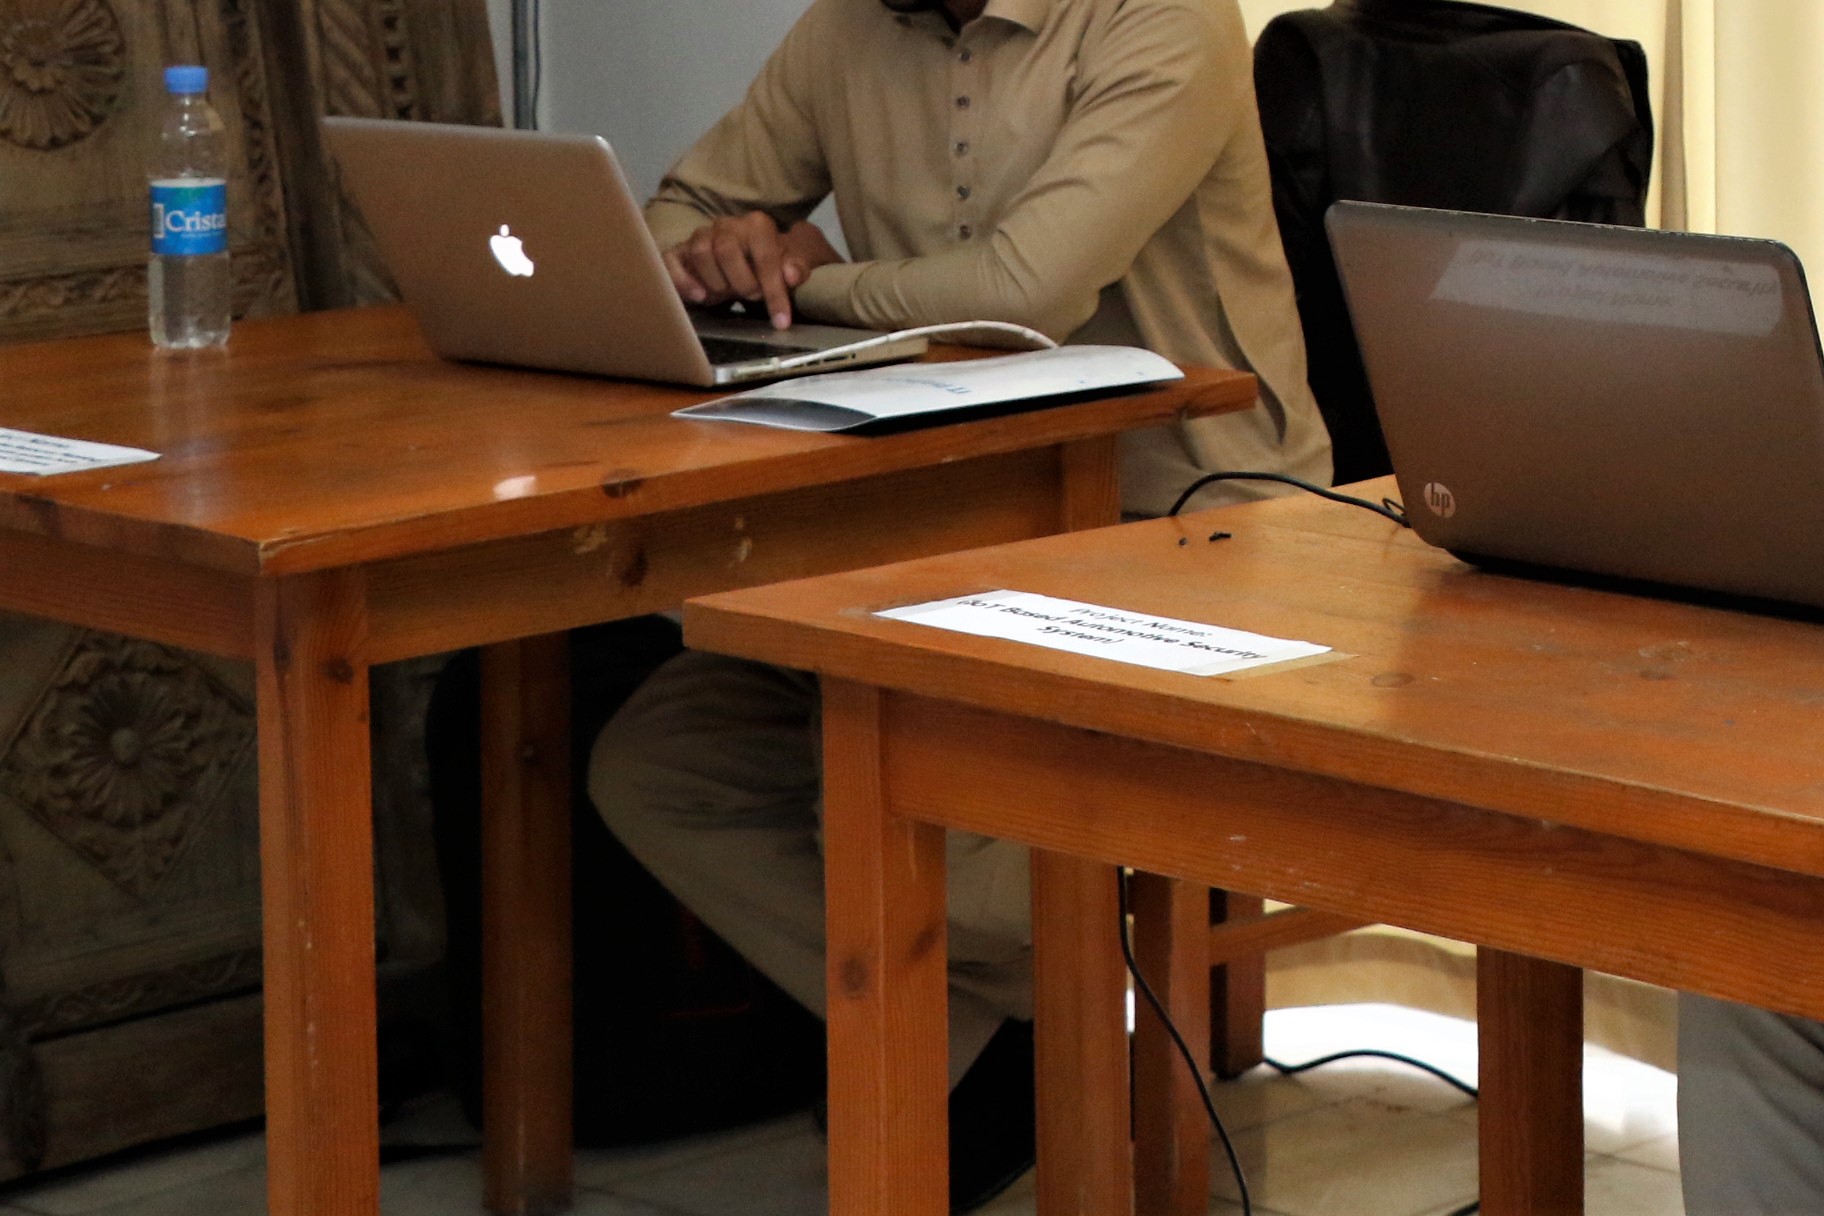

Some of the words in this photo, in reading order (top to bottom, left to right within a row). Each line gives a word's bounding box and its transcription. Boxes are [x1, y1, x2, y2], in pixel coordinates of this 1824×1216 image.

[1000, 607, 1066, 622] Based
[1062, 619, 1180, 644] Automotive
[1179, 641, 1269, 660] Security
[1069, 608, 1144, 625] Project
